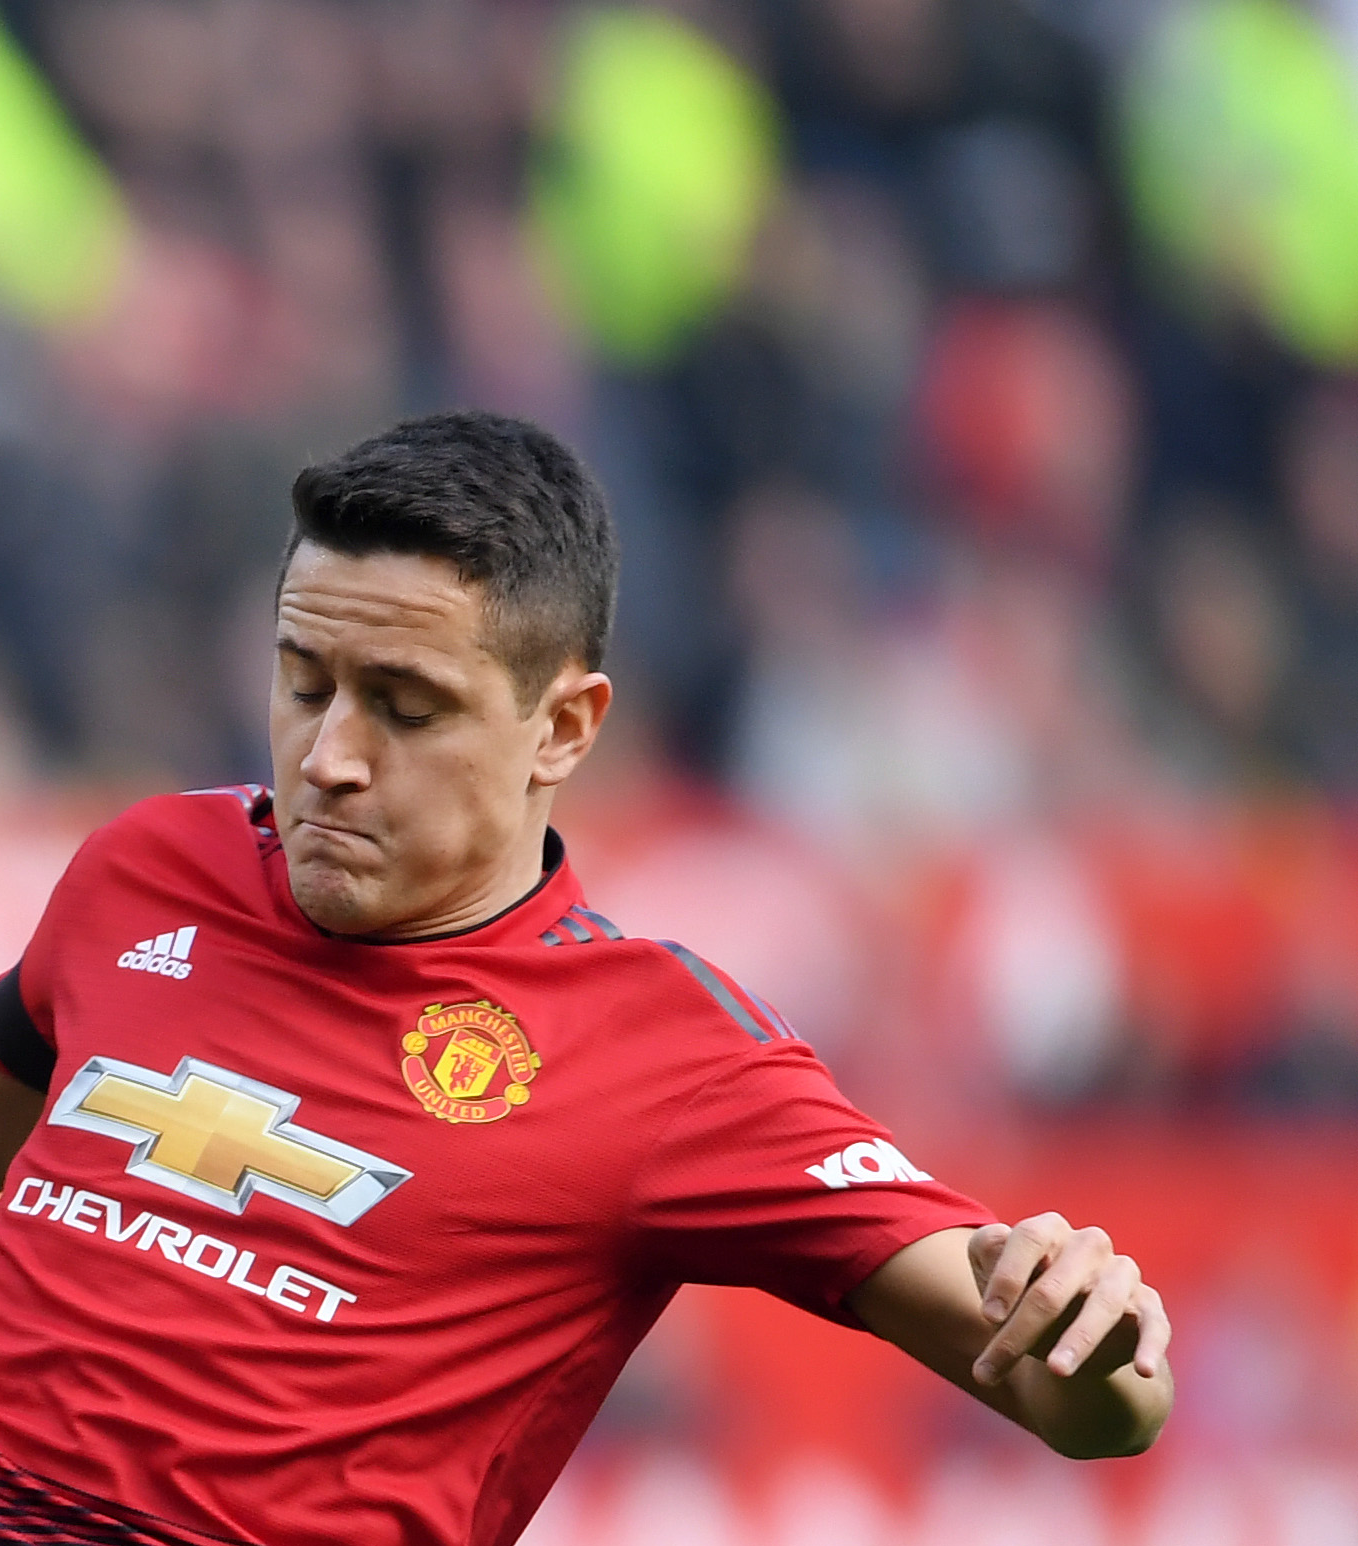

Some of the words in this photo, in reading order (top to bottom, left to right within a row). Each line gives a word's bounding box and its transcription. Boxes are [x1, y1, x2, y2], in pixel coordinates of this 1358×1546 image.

[117, 951, 193, 979] adidas
[429, 1010, 529, 1073] MANCHESTER
[414, 1079, 486, 1118] UNITED
[7, 1178, 357, 1322] CHEVROLET
